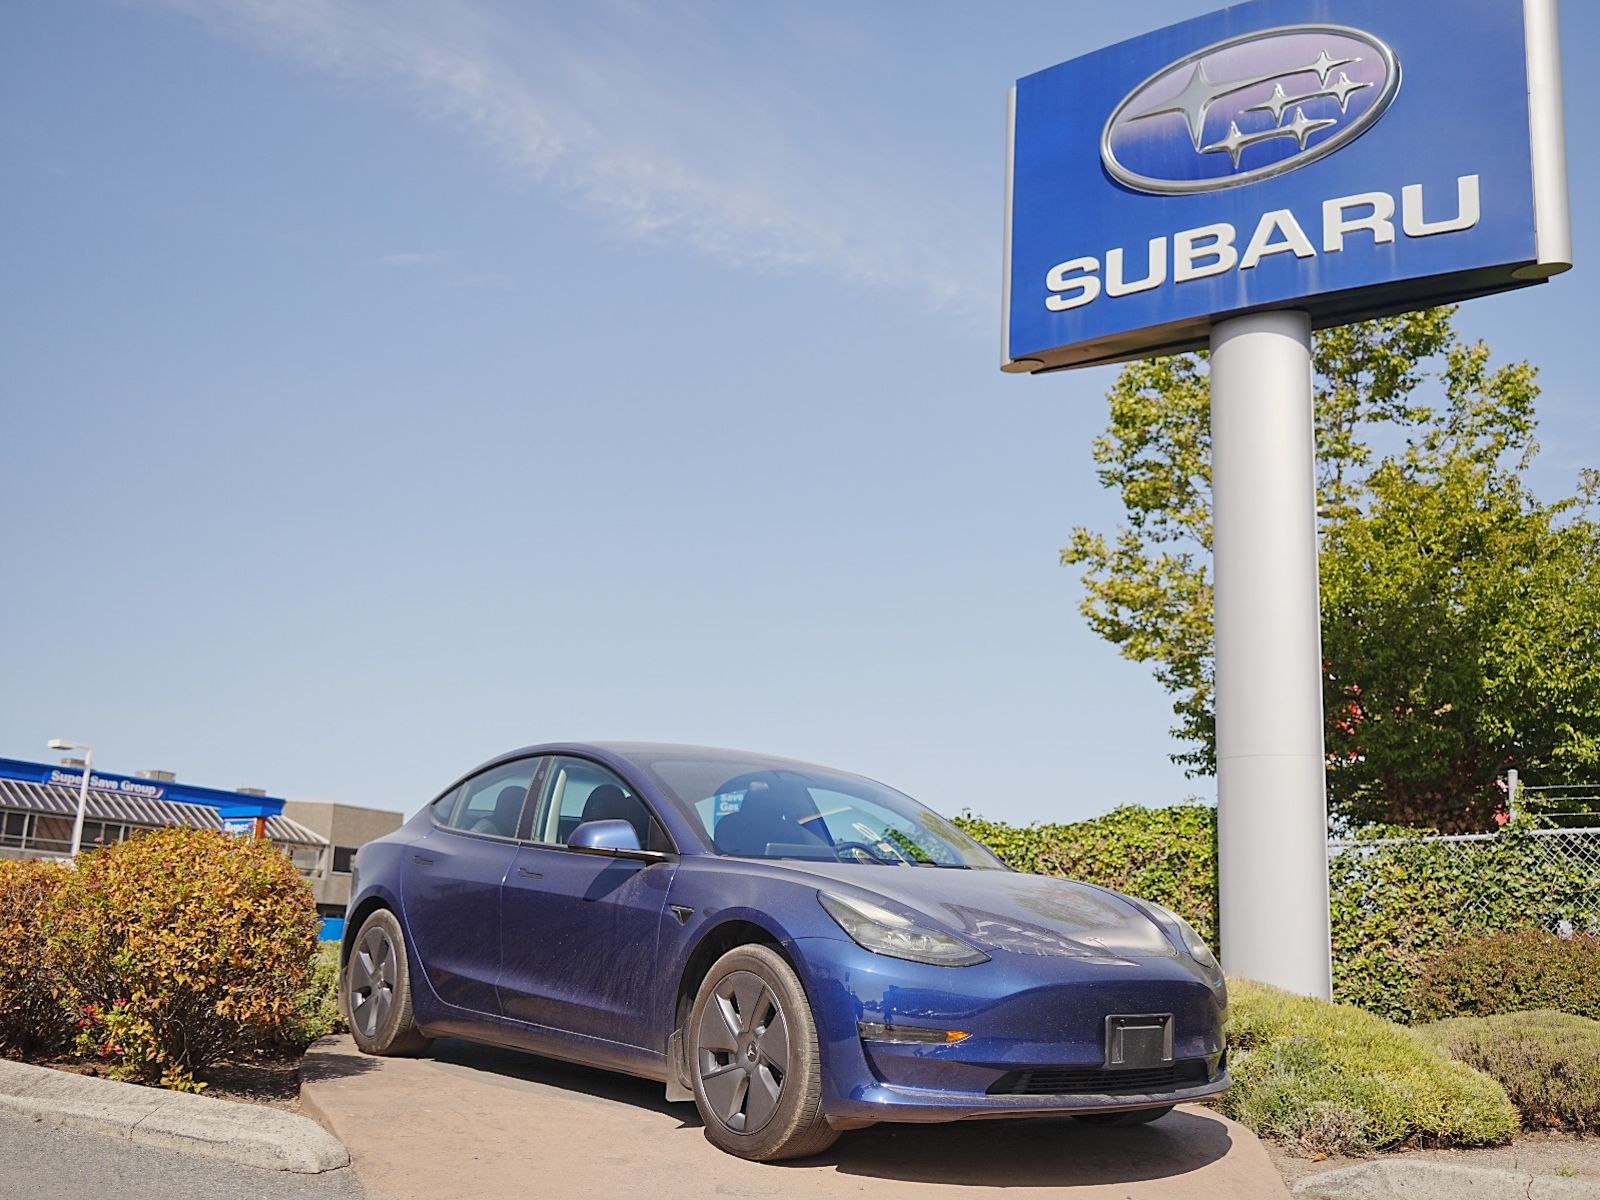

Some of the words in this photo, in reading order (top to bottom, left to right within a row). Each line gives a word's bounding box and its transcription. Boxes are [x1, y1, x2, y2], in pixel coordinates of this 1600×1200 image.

[1044, 174, 1481, 312] SUBARU
[51, 770, 85, 785] Supe
[90, 775, 119, 790] Save
[121, 780, 156, 795] Group
[720, 802, 740, 812] Gas
